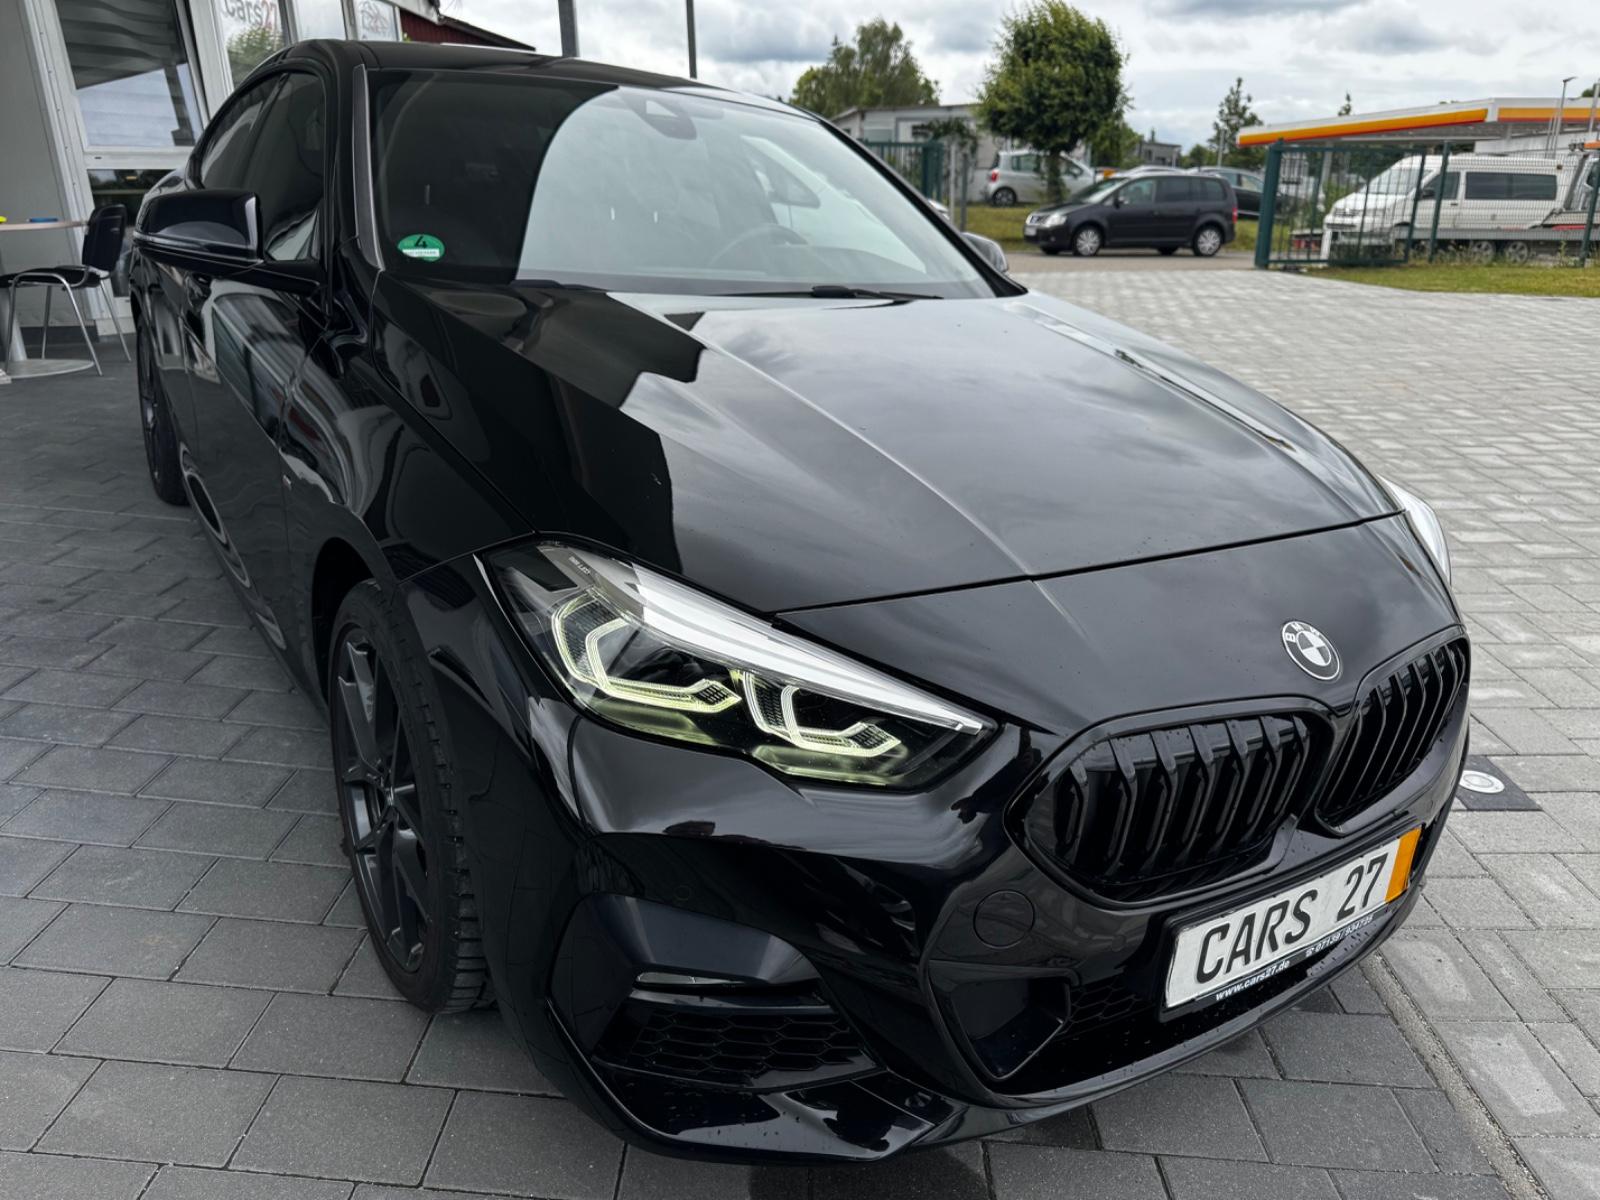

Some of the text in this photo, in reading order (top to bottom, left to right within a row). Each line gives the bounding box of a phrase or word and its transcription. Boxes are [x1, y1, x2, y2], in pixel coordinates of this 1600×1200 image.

[414, 235, 428, 248] 4
[1196, 853, 1388, 984] CARS 27
[1215, 960, 1291, 1001] www.cars27.de
